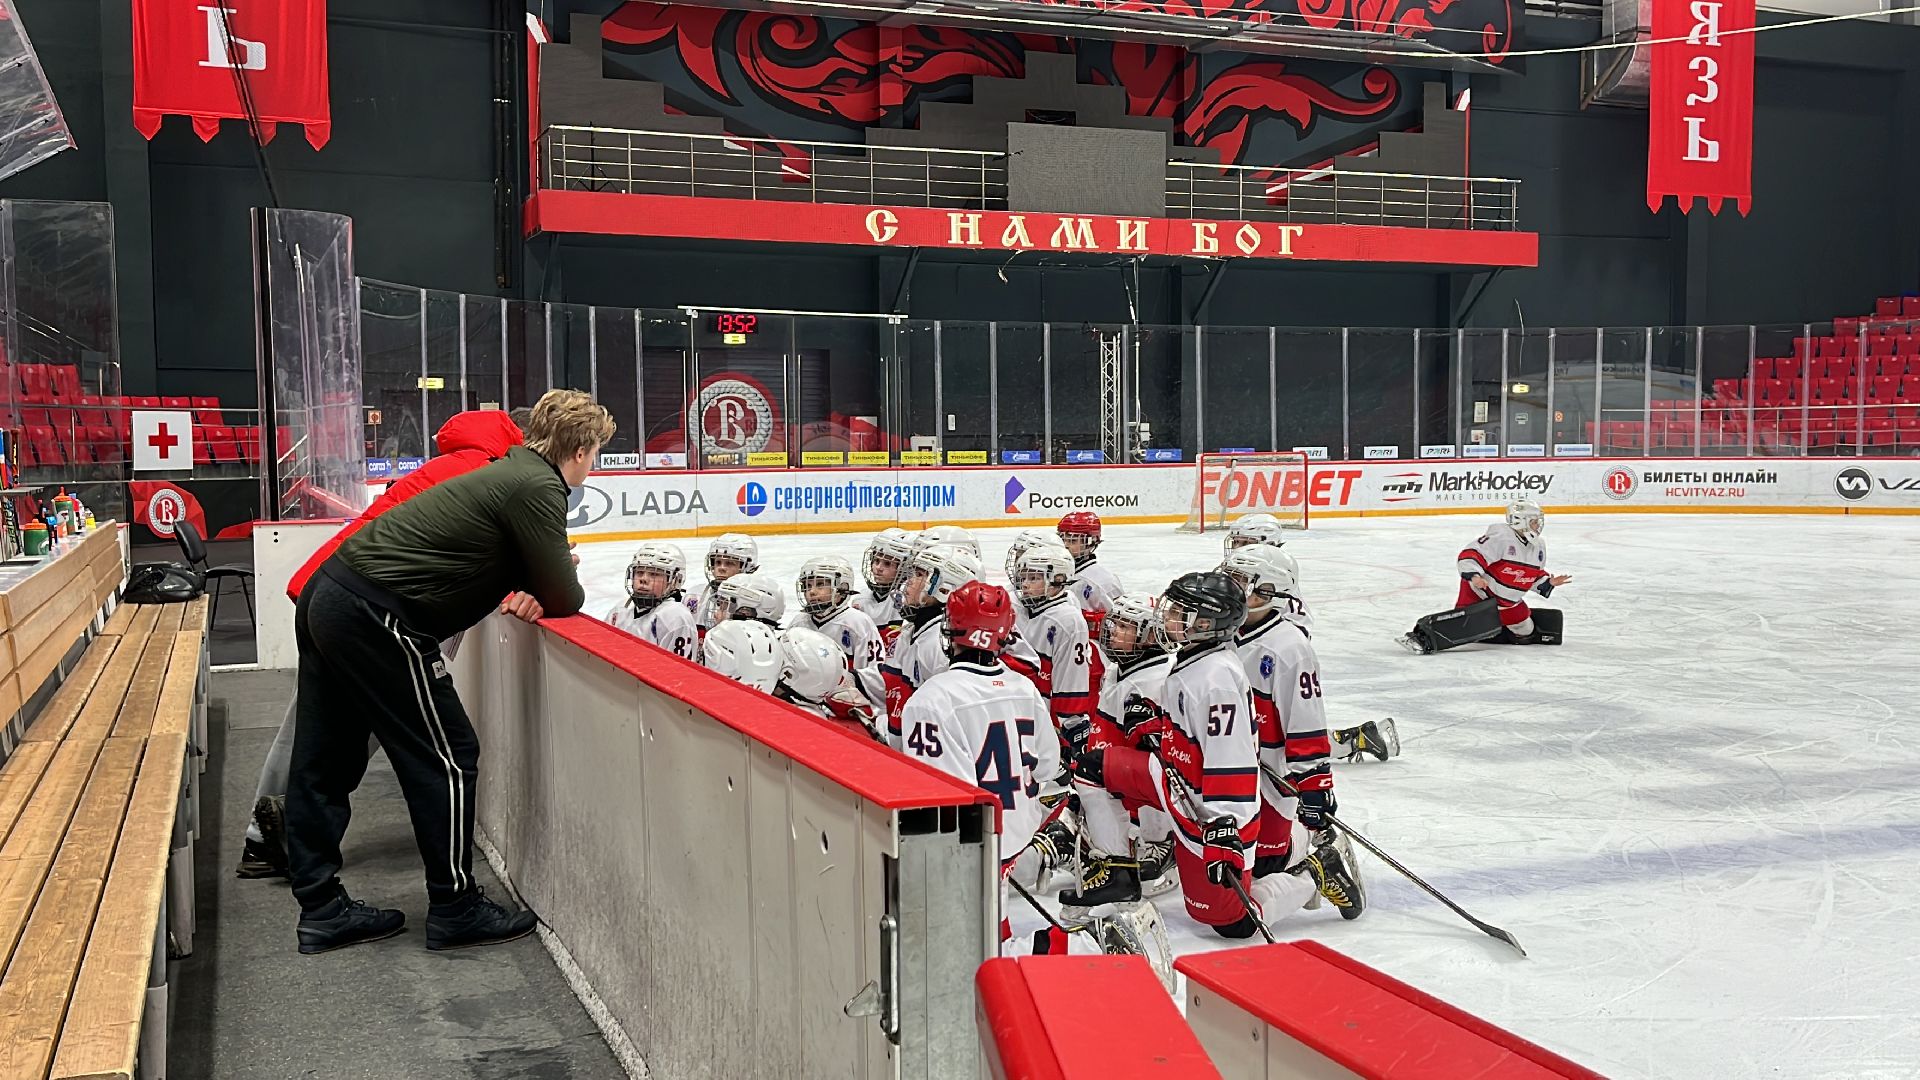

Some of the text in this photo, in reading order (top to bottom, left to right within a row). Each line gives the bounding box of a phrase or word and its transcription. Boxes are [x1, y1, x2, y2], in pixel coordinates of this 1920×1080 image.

[865, 209, 1304, 256] С НАМИ БОГ
[717, 314, 757, 334] 13:52
[603, 455, 637, 467] KHL.RU
[1642, 468, 1778, 484] БИЛЕТЫ ОНЛАЙН
[1194, 470, 1363, 508] FONBET
[1436, 492, 1530, 502] MAKE YOURSELF
[1665, 487, 1746, 498] HCVITYAZ.RU
[621, 489, 709, 516] LADA
[1029, 492, 1139, 509] Ростелеком
[968, 629, 993, 649] 45
[1207, 703, 1237, 737] 57
[907, 721, 944, 758] 45
[975, 718, 1041, 811] 45
